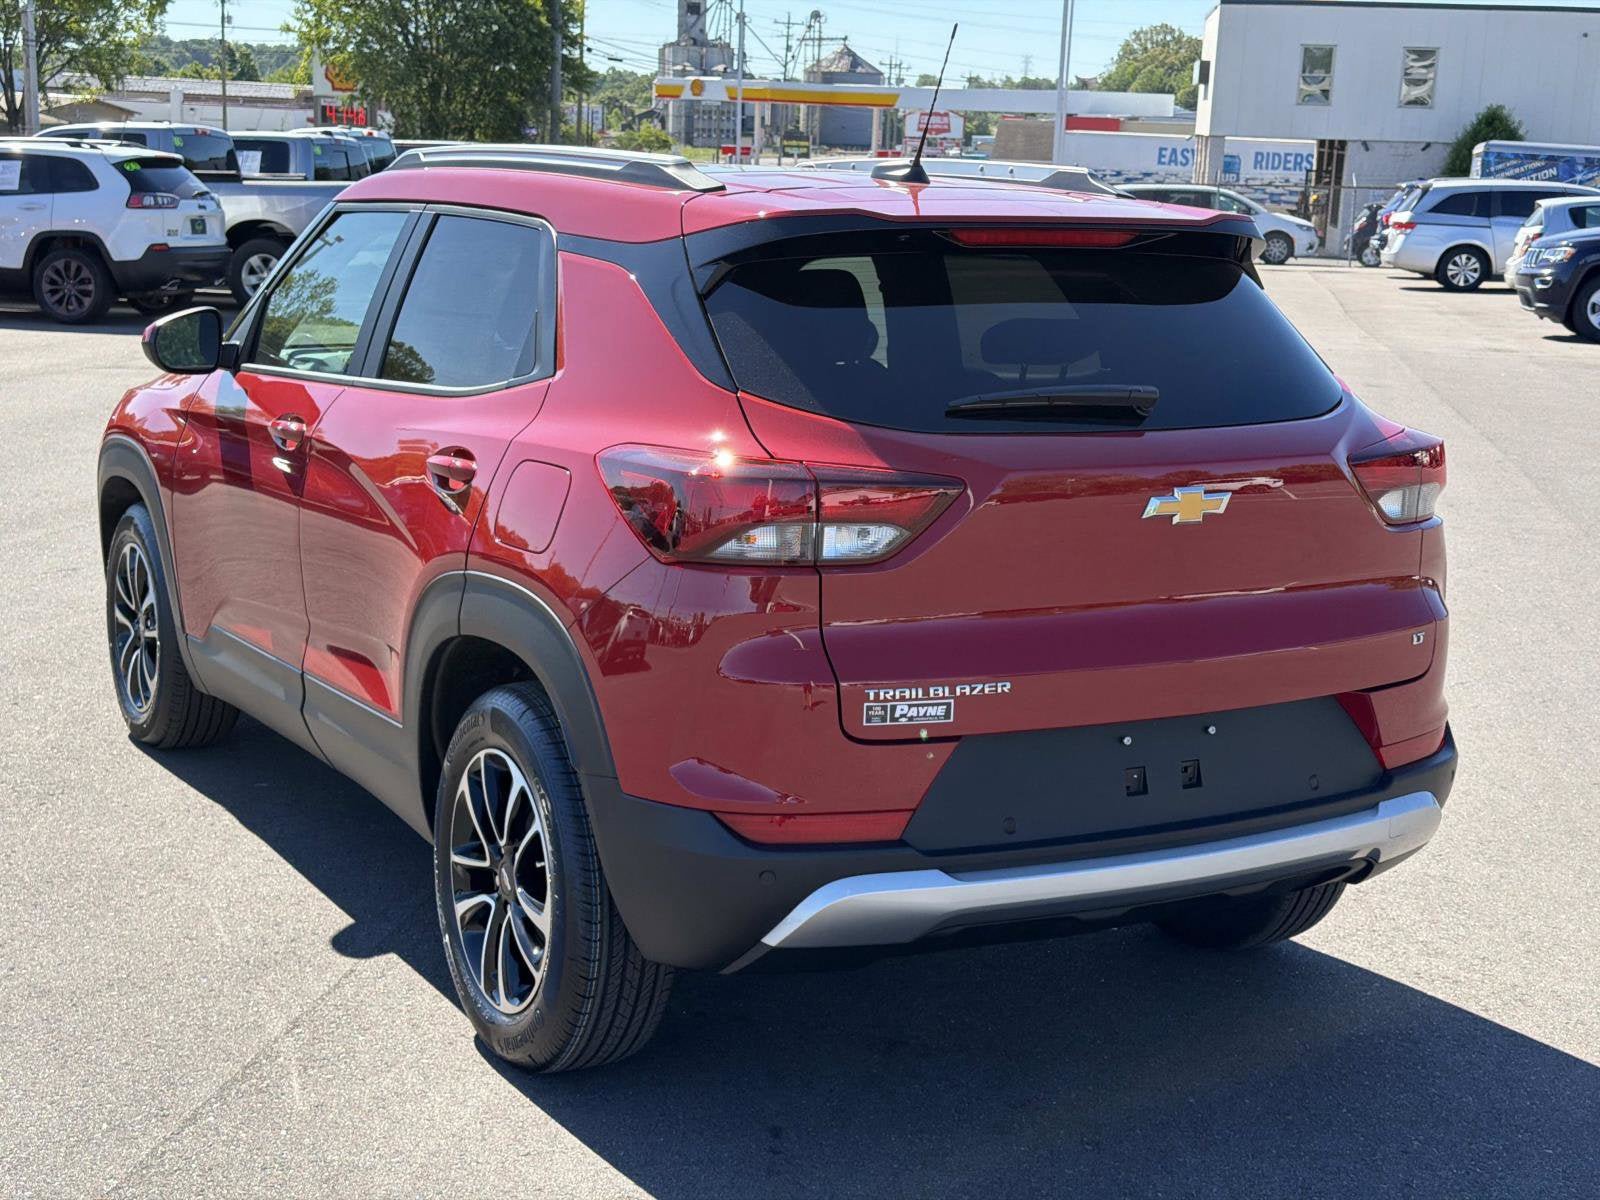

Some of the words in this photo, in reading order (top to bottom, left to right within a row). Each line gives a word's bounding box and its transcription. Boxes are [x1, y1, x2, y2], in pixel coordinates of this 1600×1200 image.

[1253, 151, 1314, 172] RIDERS
[1412, 631, 1425, 645] LT
[864, 681, 1012, 701] TRAILBLAZER
